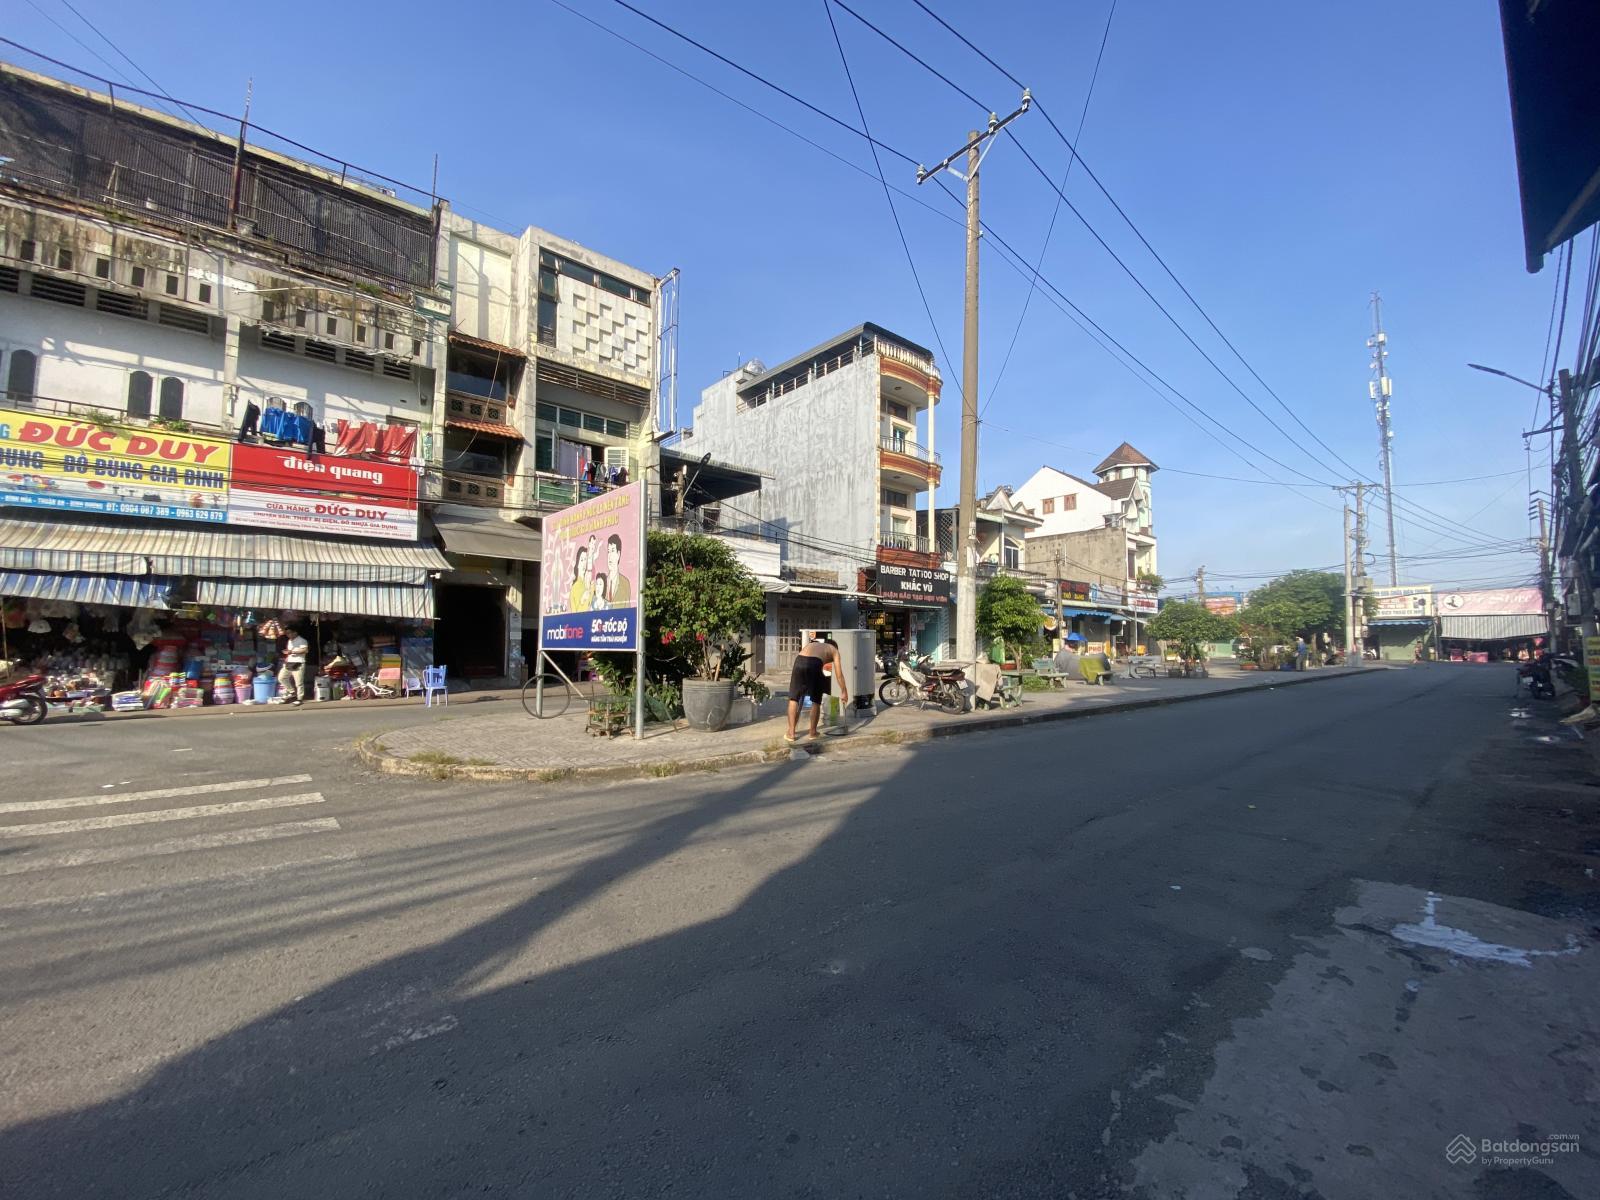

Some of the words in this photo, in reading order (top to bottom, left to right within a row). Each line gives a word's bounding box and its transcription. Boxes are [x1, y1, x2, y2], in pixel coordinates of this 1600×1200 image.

[18, 421, 117, 451] ĐỨC
[126, 435, 220, 464] DUY
[276, 455, 325, 473] điện
[330, 466, 383, 485] quang
[314, 503, 350, 517] ĐỨC
[355, 509, 388, 520] DUY
[880, 565, 906, 577] BARBER
[909, 568, 932, 580] TATTOO
[934, 571, 949, 582] SHOP
[547, 623, 584, 640] mobifone
